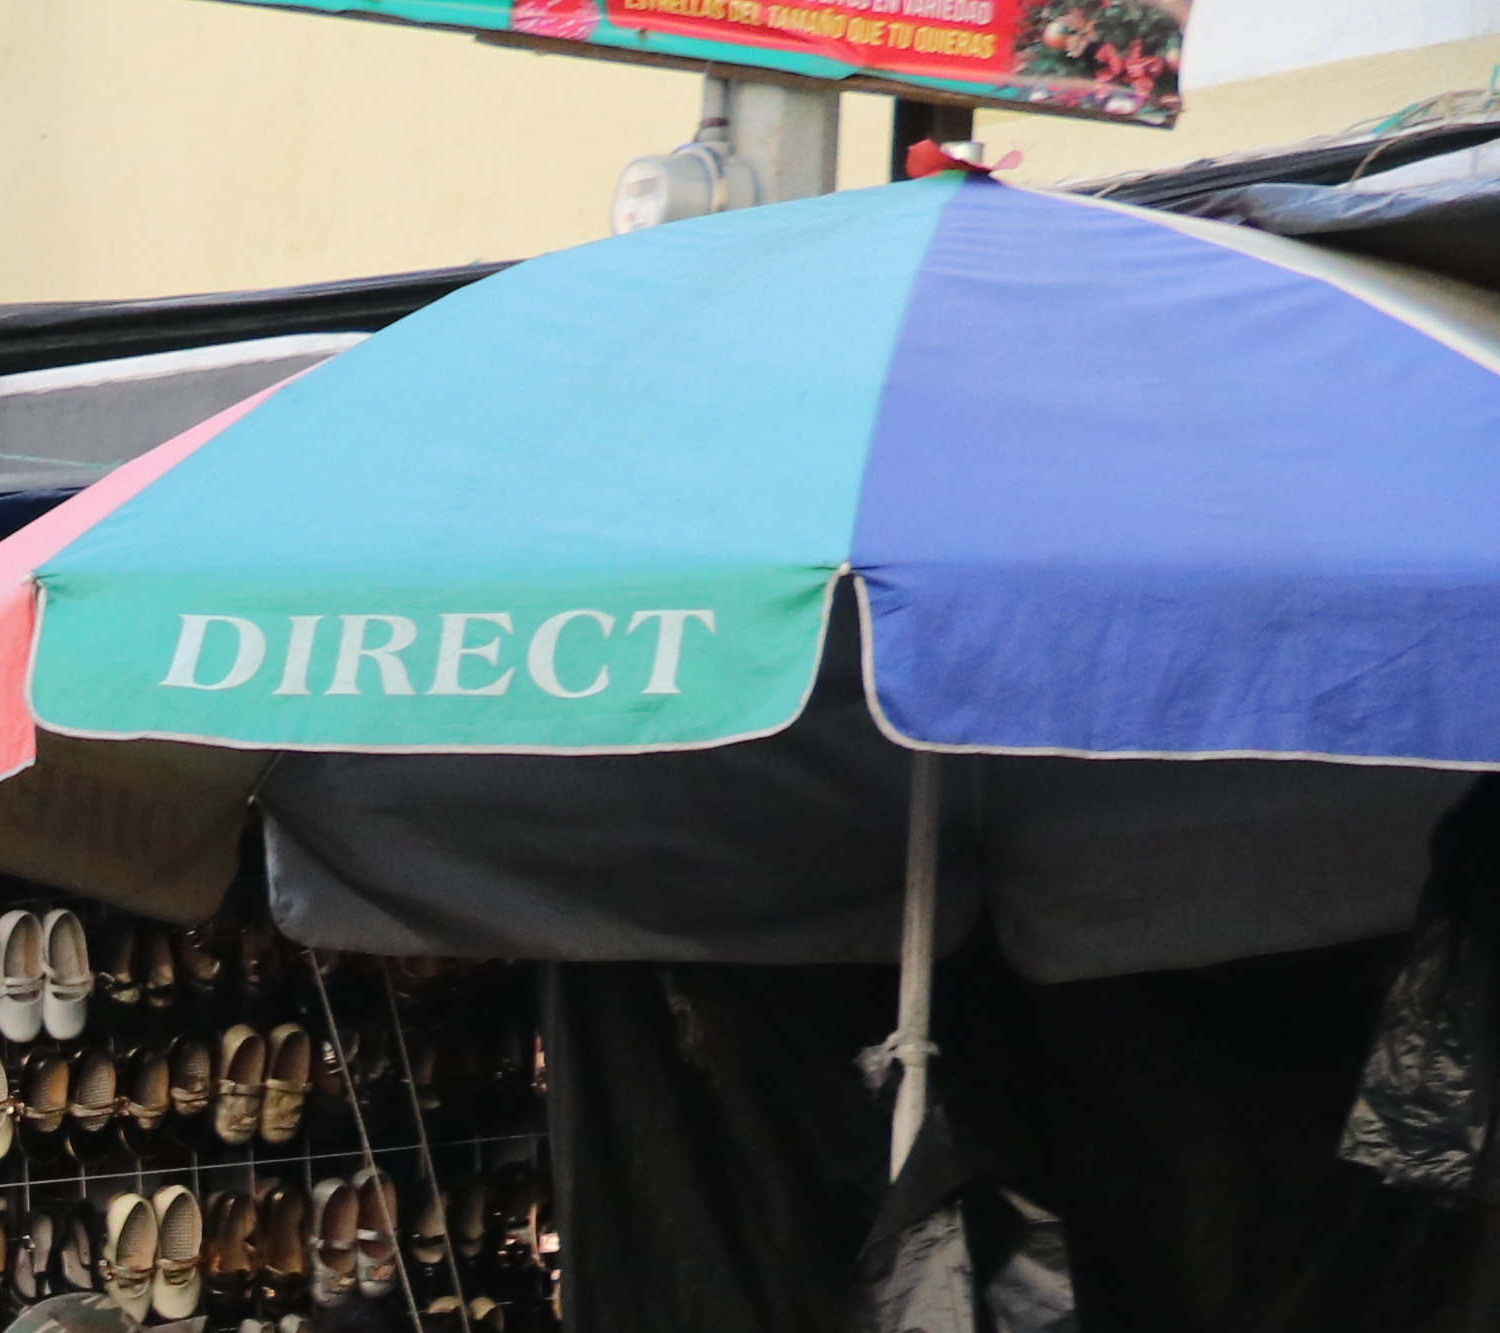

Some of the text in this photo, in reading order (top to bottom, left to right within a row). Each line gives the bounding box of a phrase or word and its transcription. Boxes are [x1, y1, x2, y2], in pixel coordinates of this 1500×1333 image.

[846, 17, 887, 45] QUE
[888, 22, 914, 49] TU
[914, 26, 997, 59] QUIERAS
[159, 608, 716, 698] DIRECT
